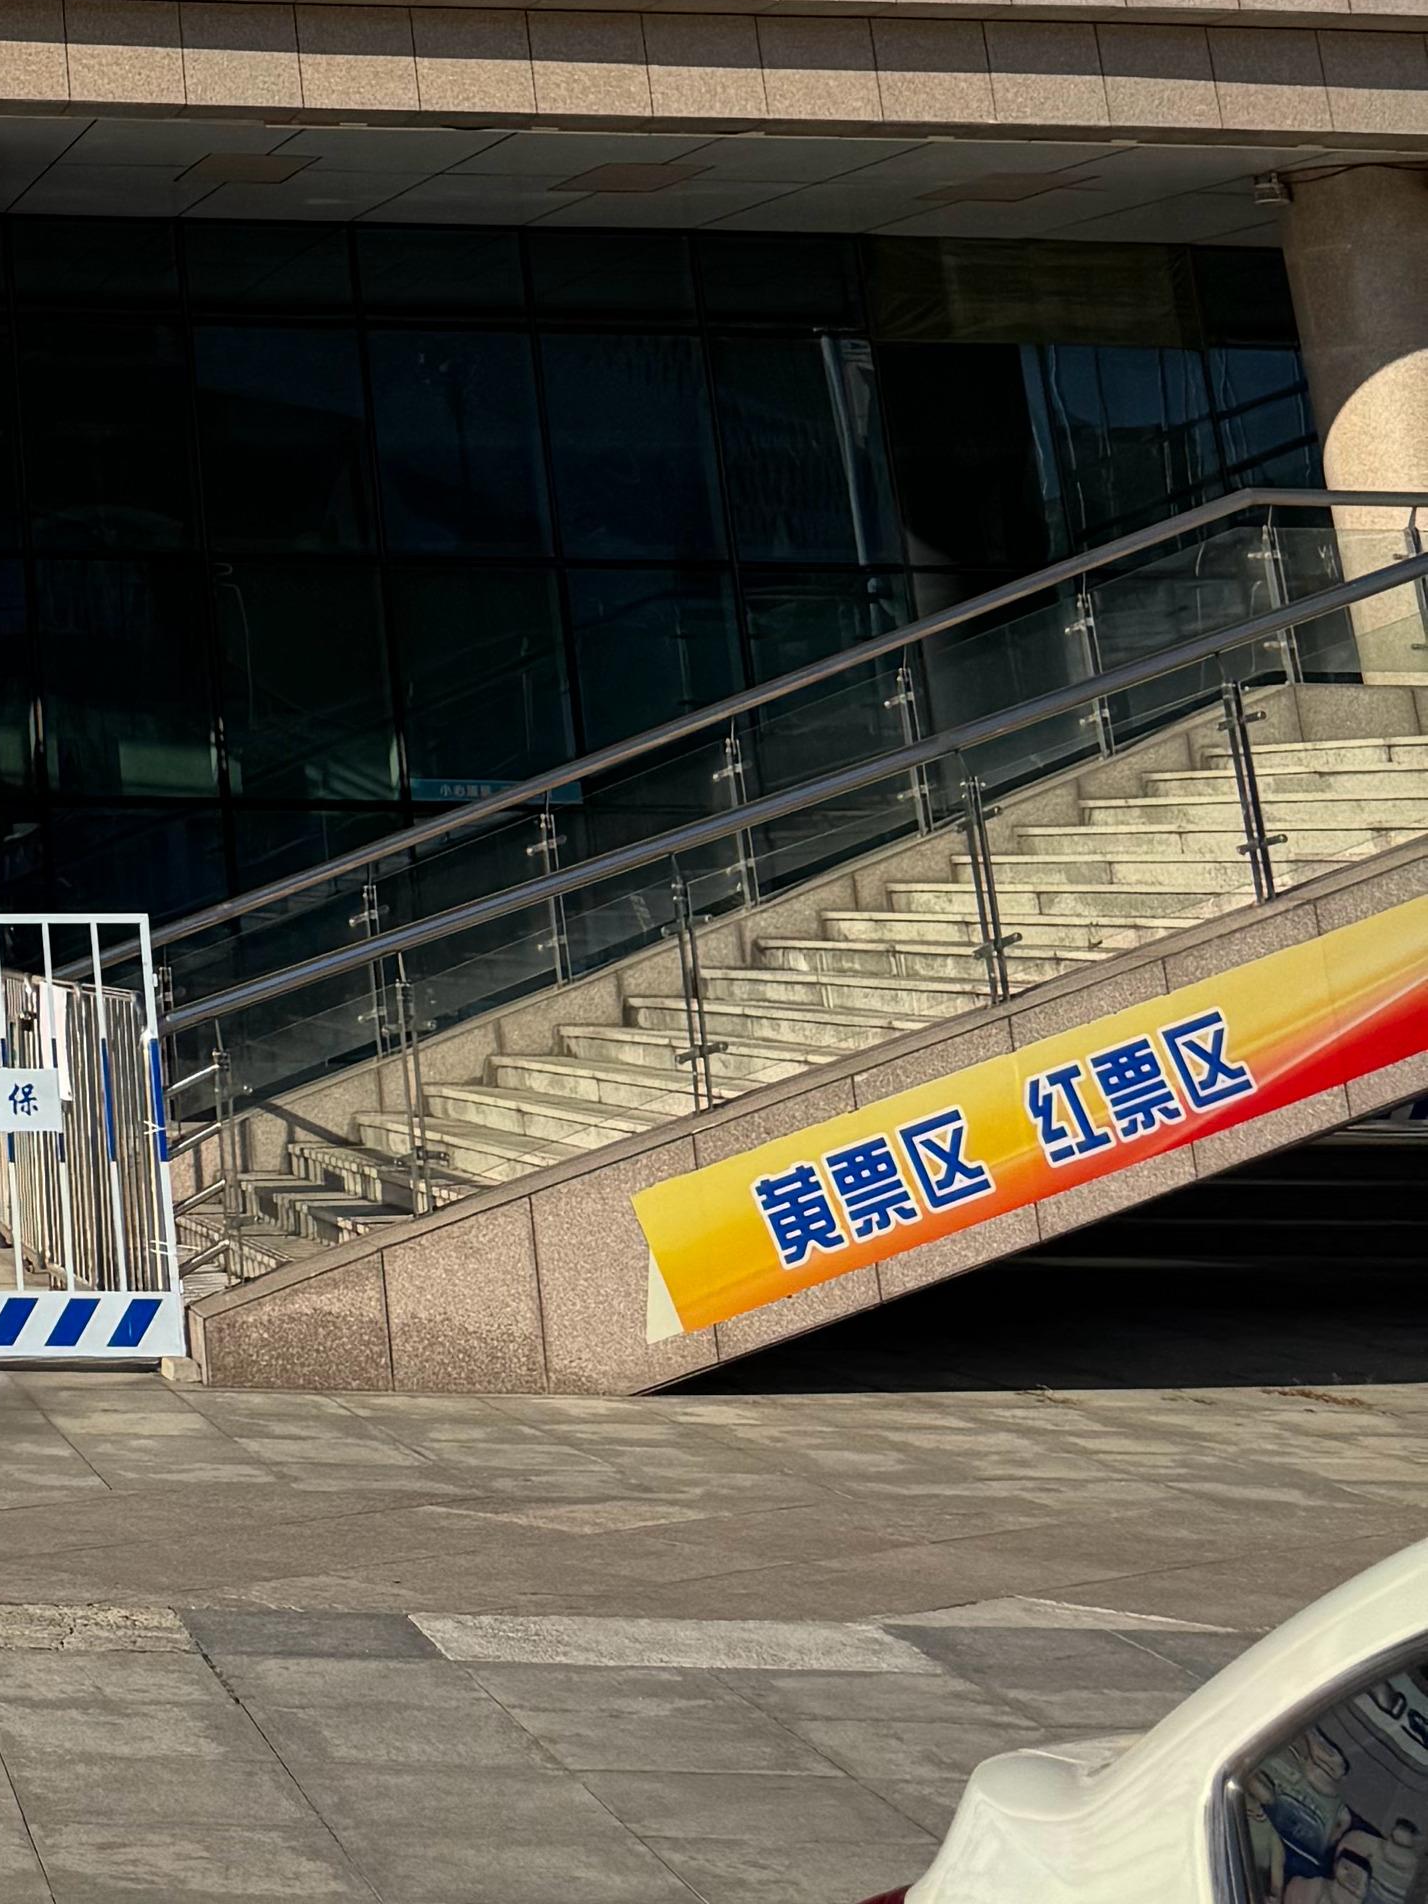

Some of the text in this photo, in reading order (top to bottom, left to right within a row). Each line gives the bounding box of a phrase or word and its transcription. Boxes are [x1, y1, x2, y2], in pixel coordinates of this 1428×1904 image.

[754, 1006, 1257, 1267] 黄票区 红票区
